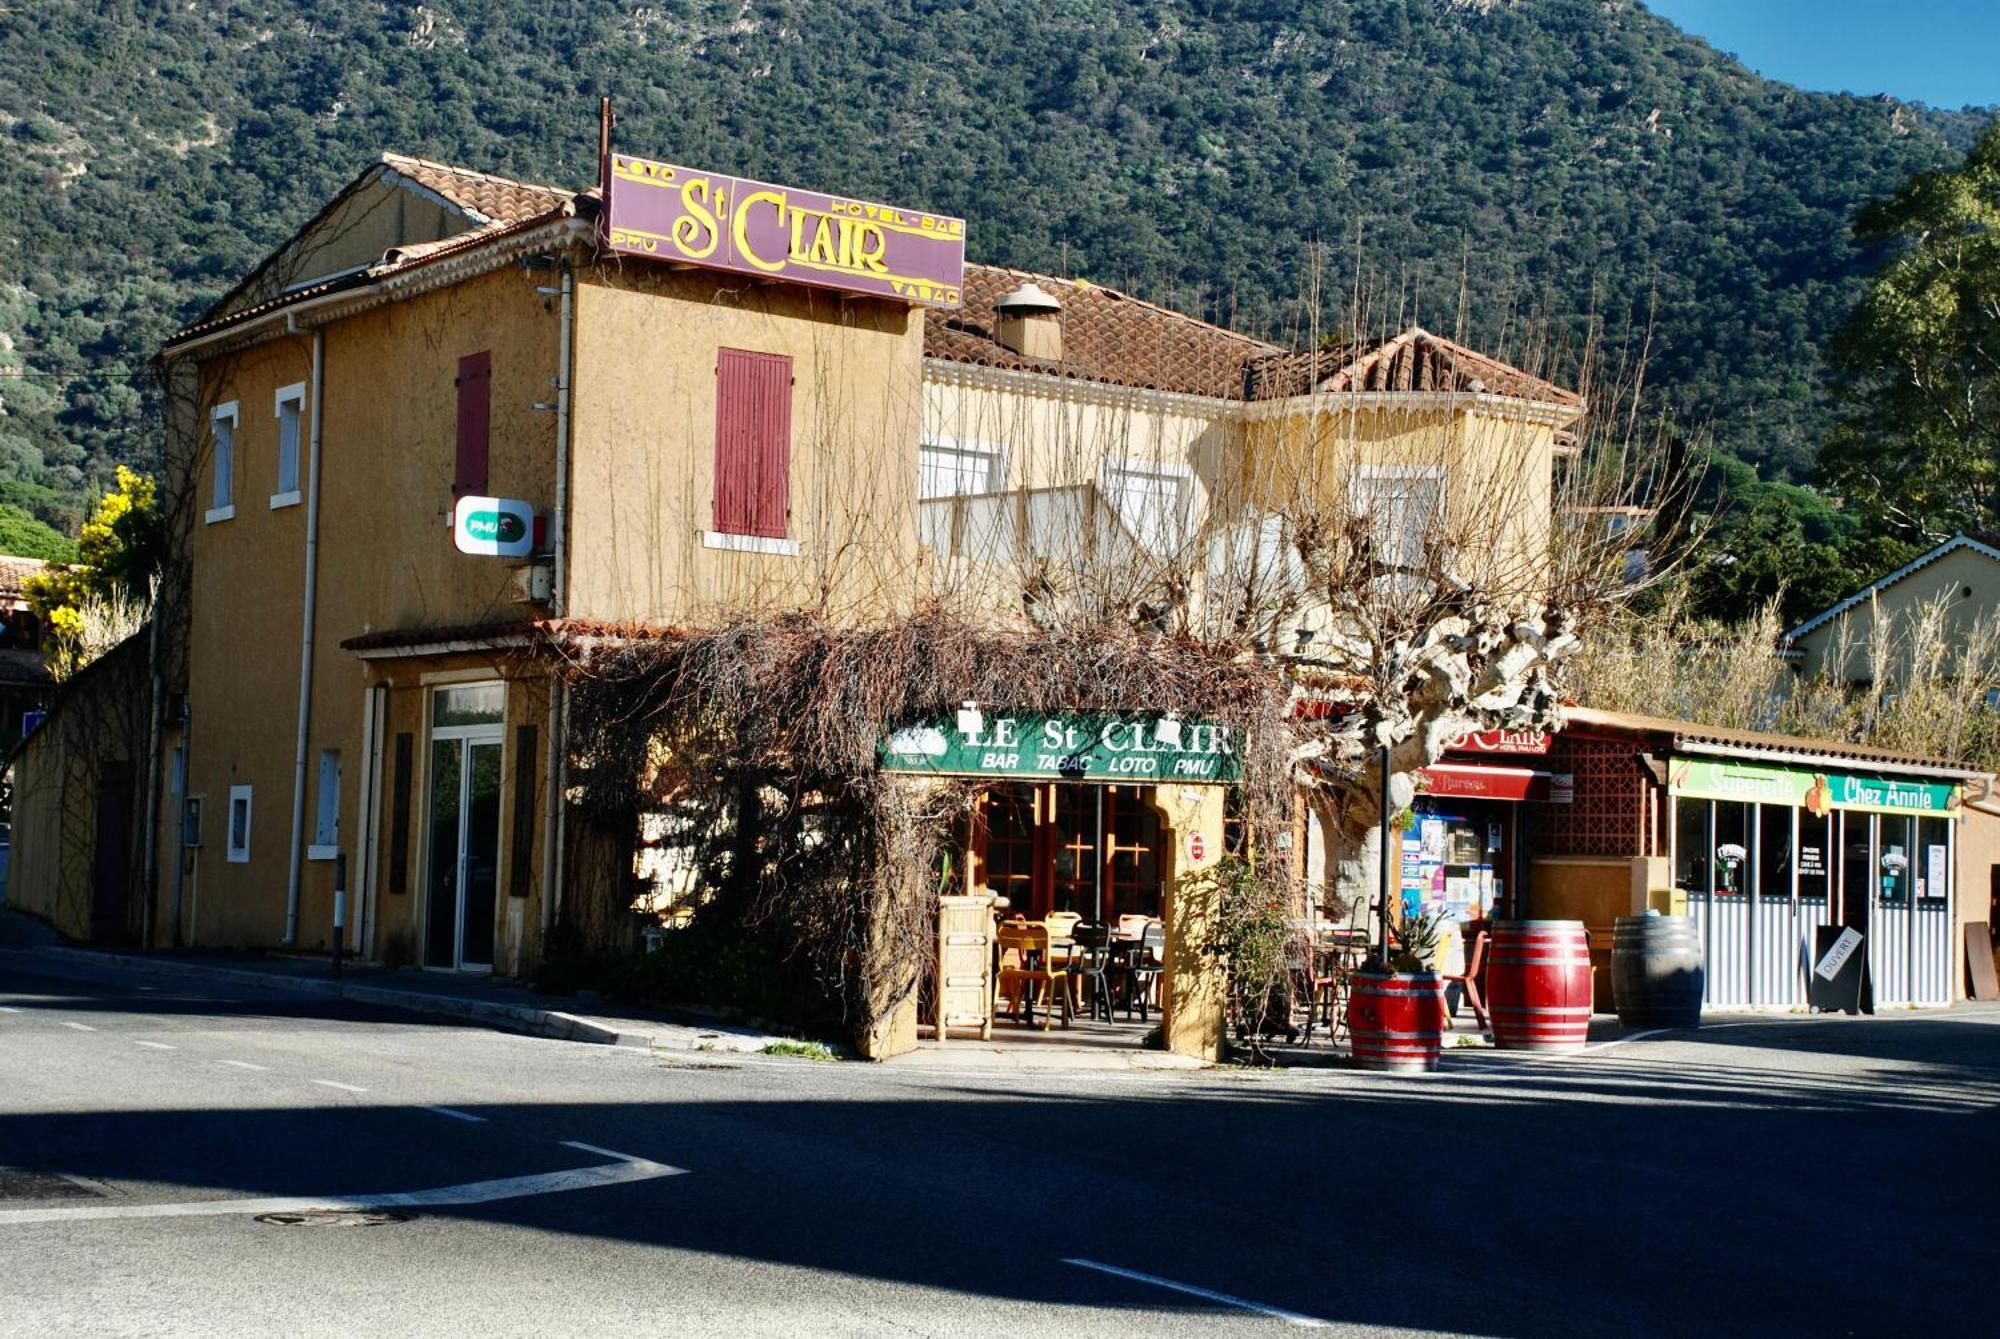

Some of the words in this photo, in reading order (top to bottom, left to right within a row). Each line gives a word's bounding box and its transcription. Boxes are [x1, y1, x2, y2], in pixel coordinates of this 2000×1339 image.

[614, 157, 675, 181] LOTO
[672, 177, 727, 260] St
[733, 191, 890, 273] CLAIR
[611, 232, 657, 253] PMU
[890, 280, 959, 304] TABAC
[470, 520, 498, 533] PMU
[1043, 719, 1078, 751] St
[981, 753, 1020, 769] BAR
[1036, 755, 1093, 771] TABAC
[1108, 757, 1157, 773] LOTO
[1173, 759, 1215, 775] PMU
[1844, 777, 1881, 805] Chez
[1886, 783, 1932, 810] Annie
[1824, 938, 1853, 973] OUVERT
